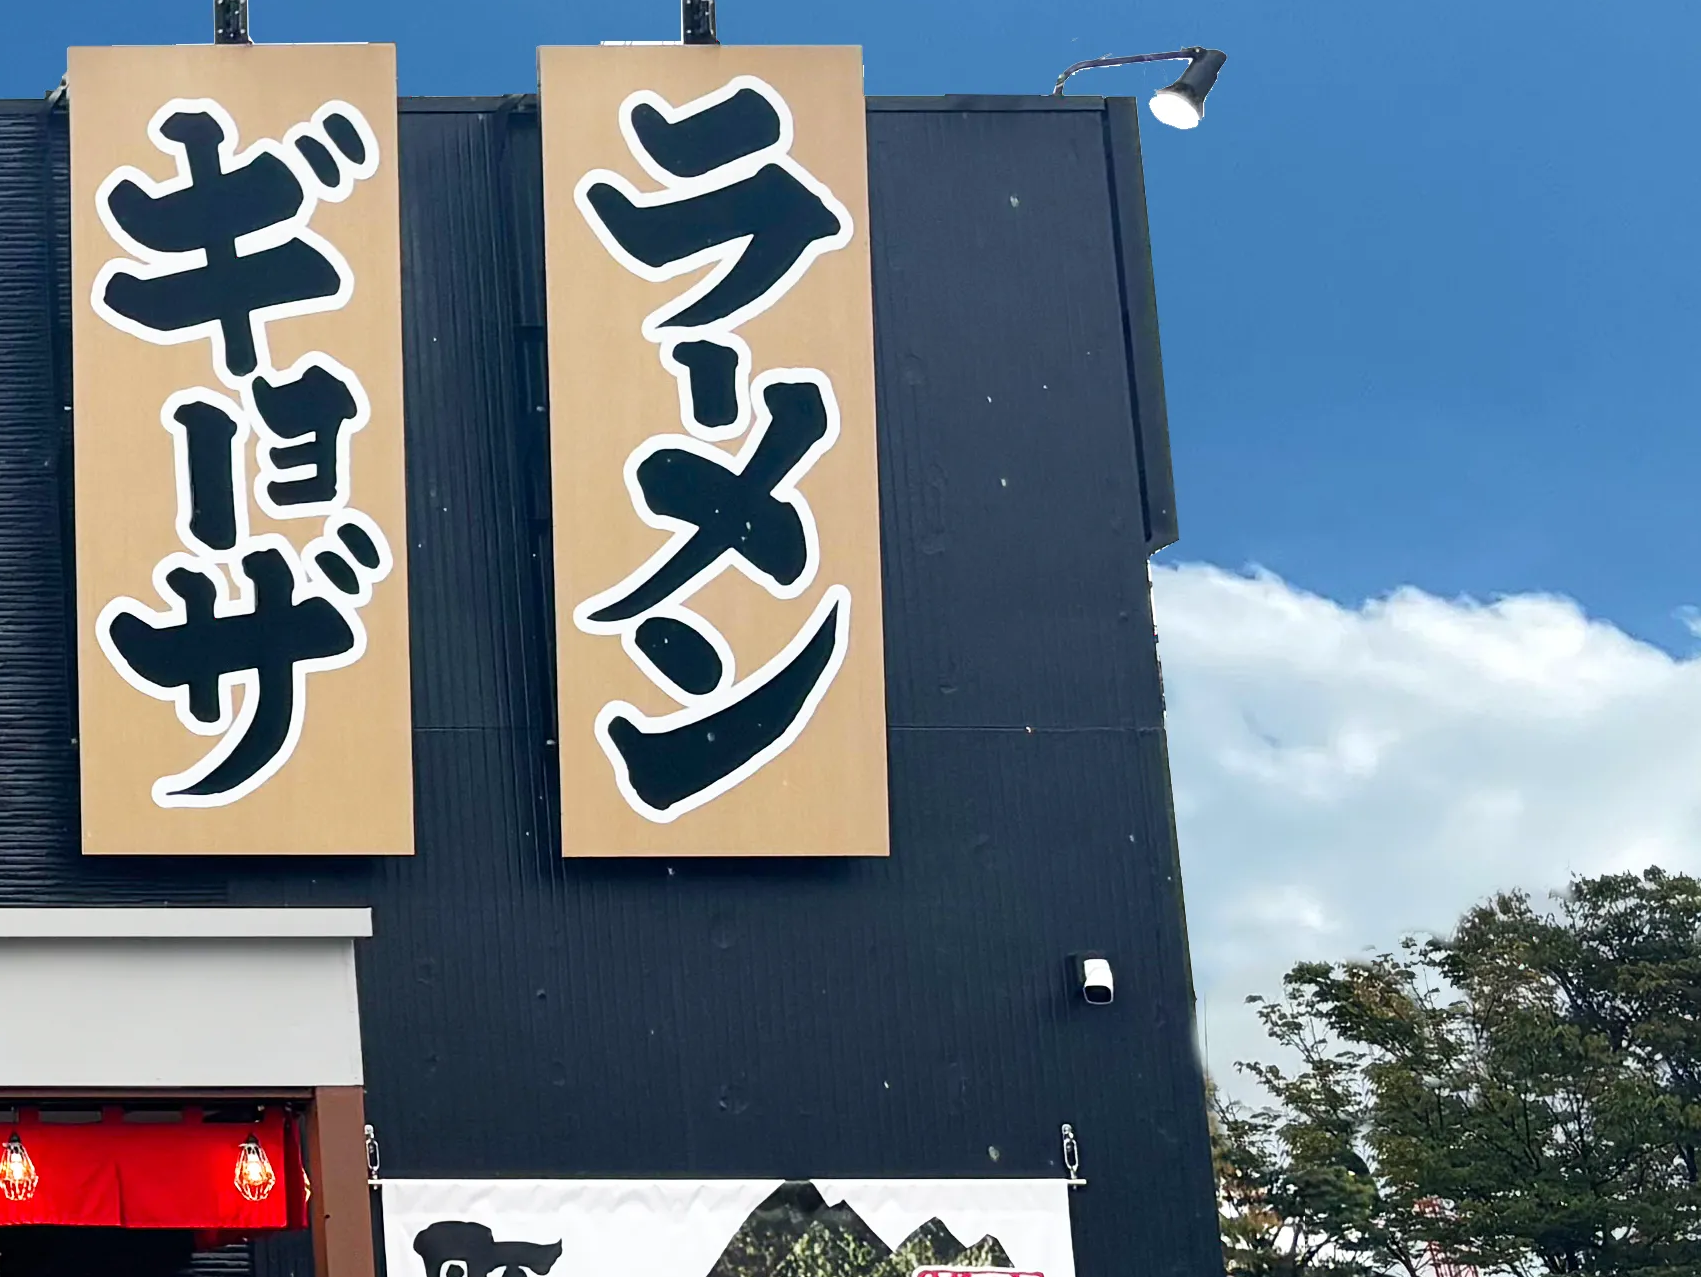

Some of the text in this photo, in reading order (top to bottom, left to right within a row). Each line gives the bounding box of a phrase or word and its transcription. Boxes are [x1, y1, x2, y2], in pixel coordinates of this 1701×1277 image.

[92, 97, 393, 808] ギョーザ
[574, 75, 853, 823] ラーメン
